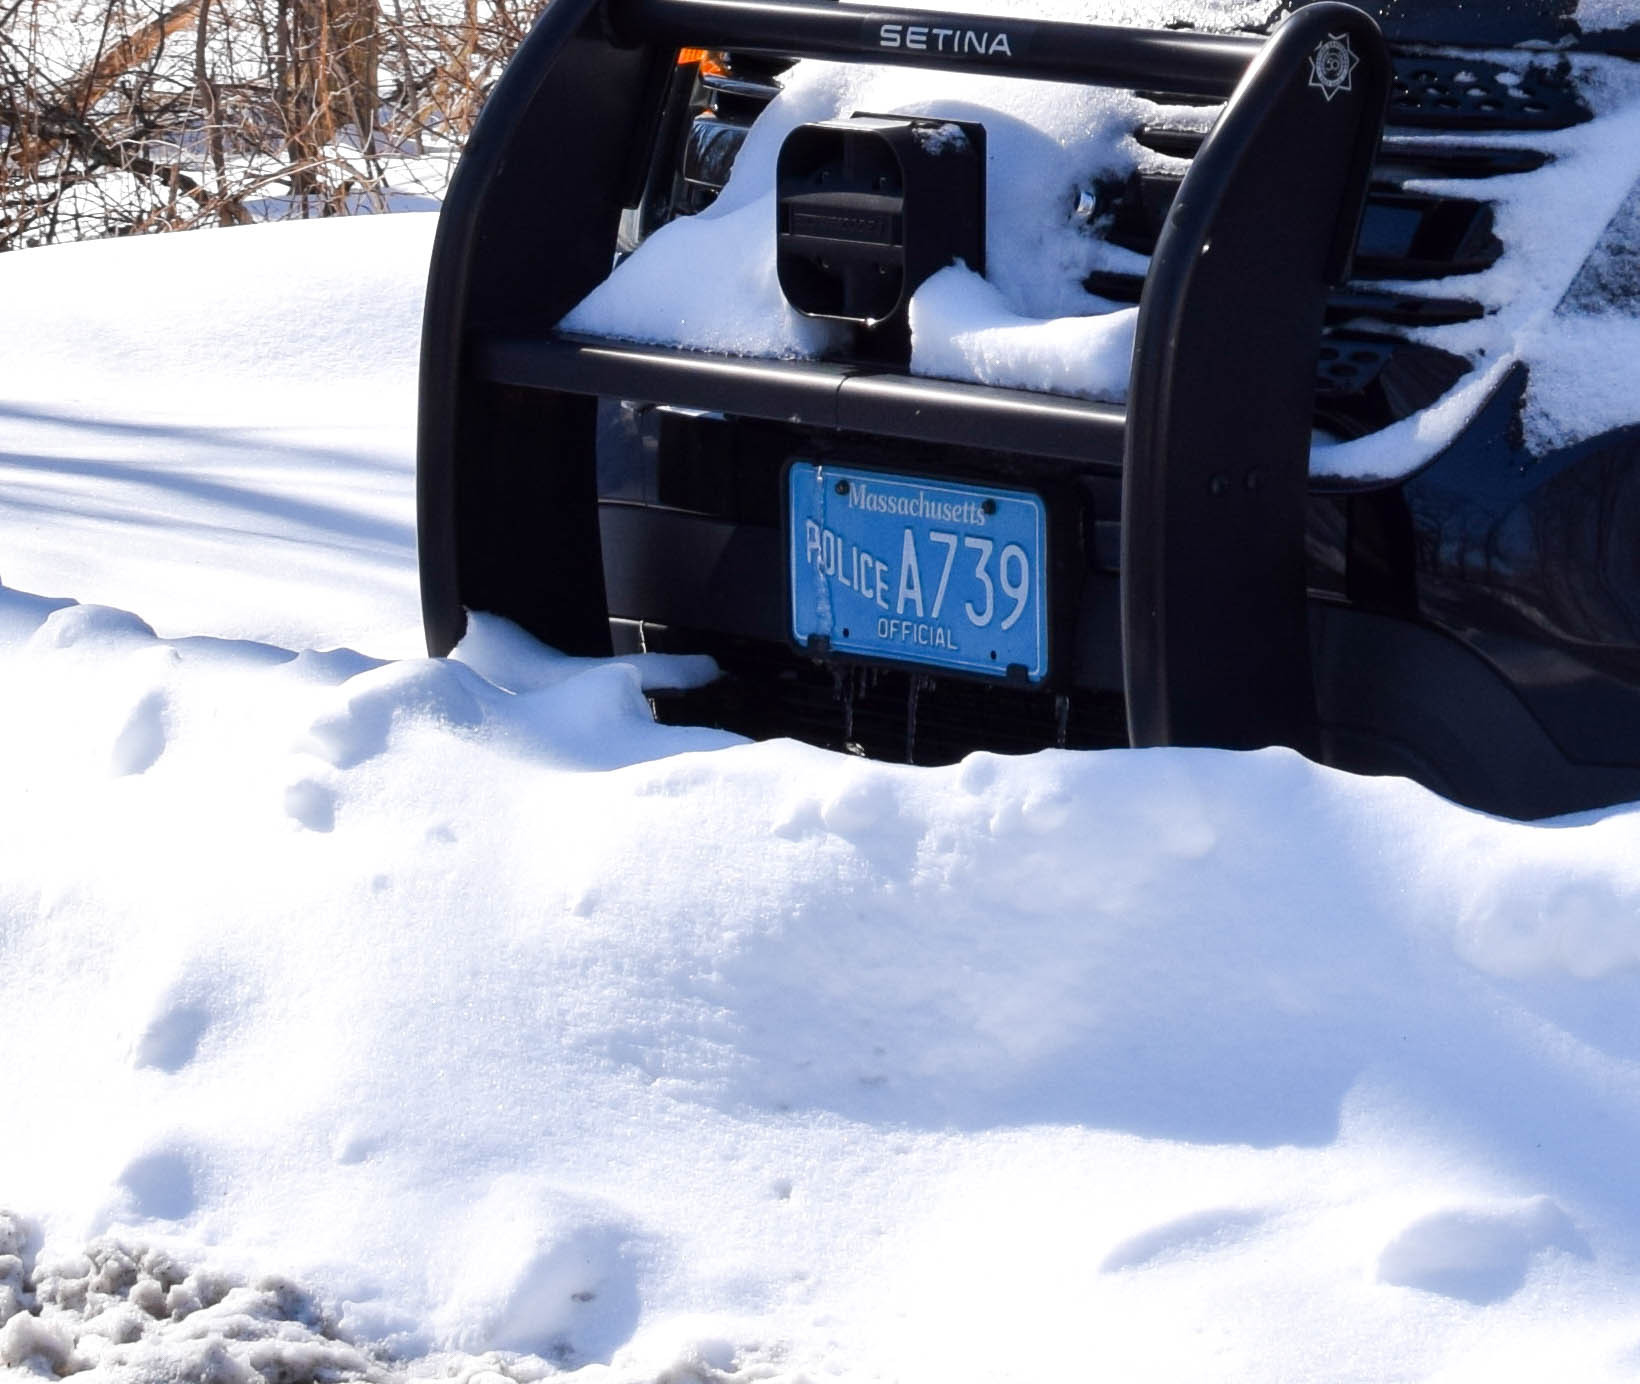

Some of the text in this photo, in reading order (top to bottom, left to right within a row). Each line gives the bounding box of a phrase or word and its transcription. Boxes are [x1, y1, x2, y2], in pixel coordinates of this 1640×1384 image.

[879, 23, 1013, 57] SETINA
[847, 480, 987, 527] Massachusetts
[805, 518, 1030, 631] POLICE A739
[877, 617, 959, 651] OFFICIAL
